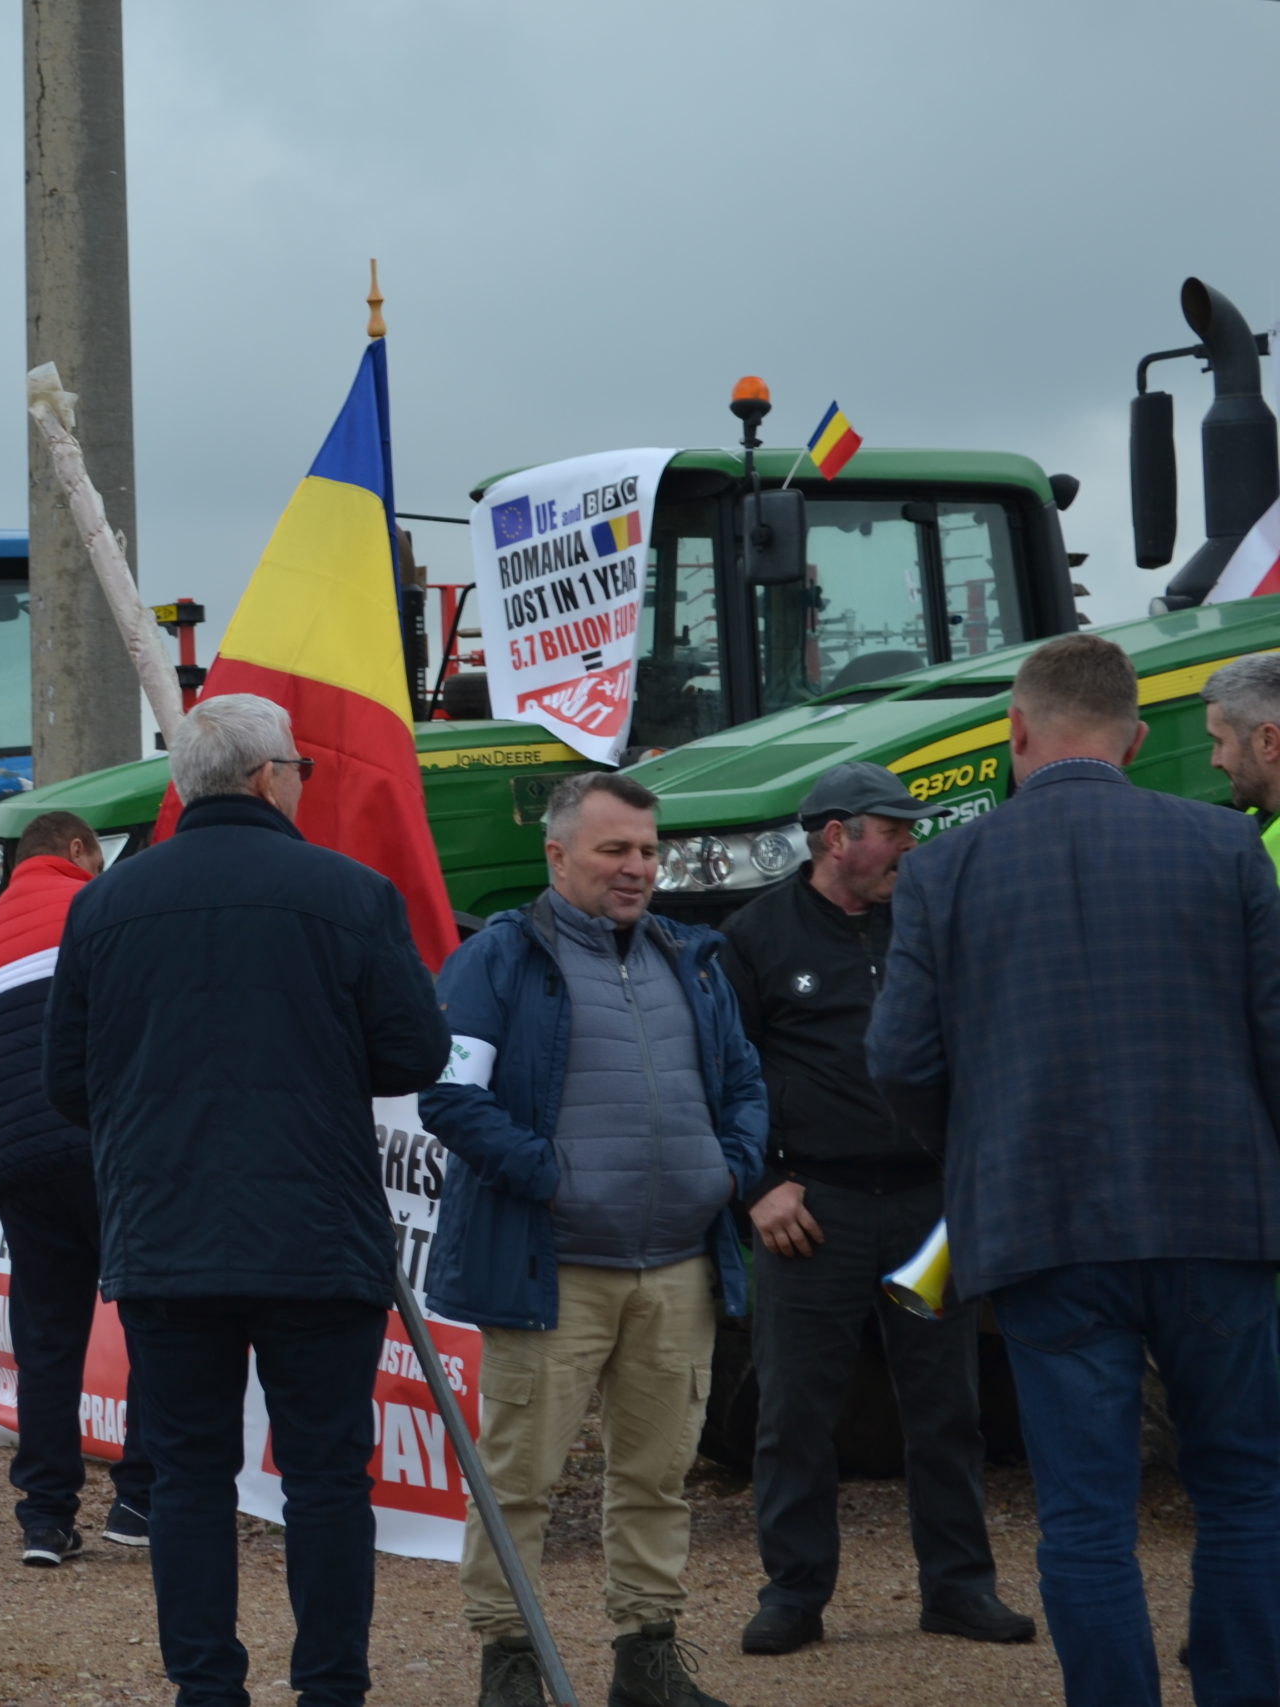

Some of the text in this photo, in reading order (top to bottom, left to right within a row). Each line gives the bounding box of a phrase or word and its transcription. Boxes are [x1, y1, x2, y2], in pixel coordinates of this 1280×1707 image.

[535, 475, 639, 535] UE and BBC
[498, 530, 590, 589] ROMANIA
[504, 556, 637, 631] LOST IN 1 YEAR
[510, 601, 638, 671] 5.7 BILION EUR
[456, 750, 542, 767] JOHN DEERE
[909, 757, 998, 802] 8370 R
